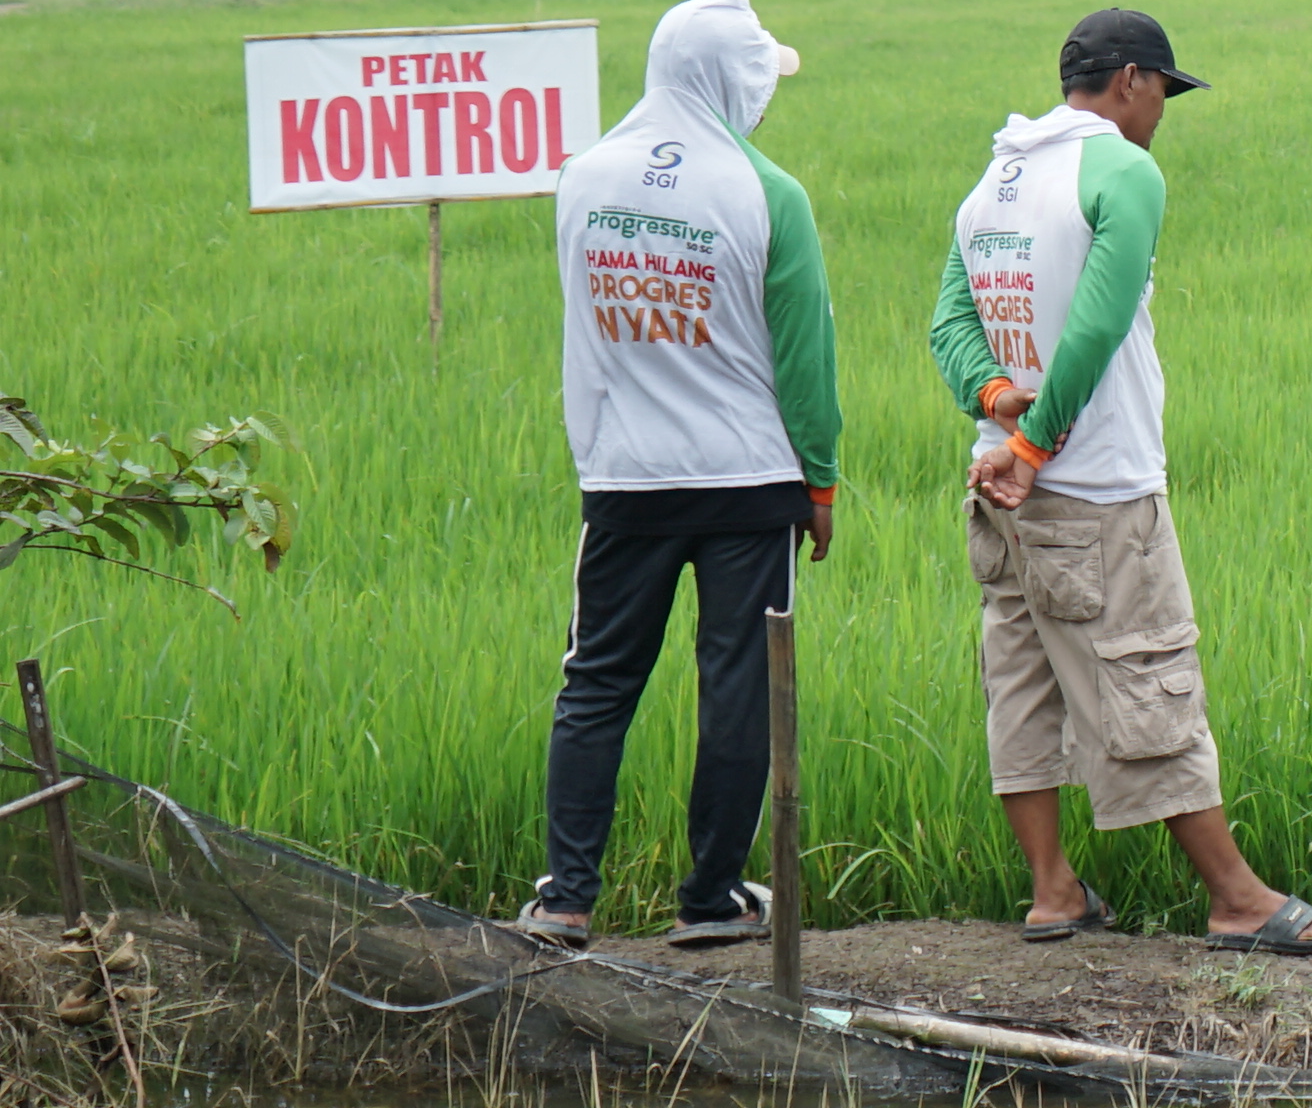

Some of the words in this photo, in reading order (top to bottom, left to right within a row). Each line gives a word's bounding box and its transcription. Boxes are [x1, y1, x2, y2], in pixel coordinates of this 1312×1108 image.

[361, 50, 488, 88] PETAK
[279, 86, 575, 185] KONTROL
[642, 171, 679, 190] SGI
[997, 186, 1019, 202] SGI
[587, 210, 715, 245] Progressive
[585, 249, 639, 271] HAMA
[644, 253, 717, 283] HILANG
[699, 243, 714, 255] SC
[588, 272, 713, 311] PROGRES
[995, 271, 1034, 292] HILANG
[594, 305, 715, 348] NYATA
